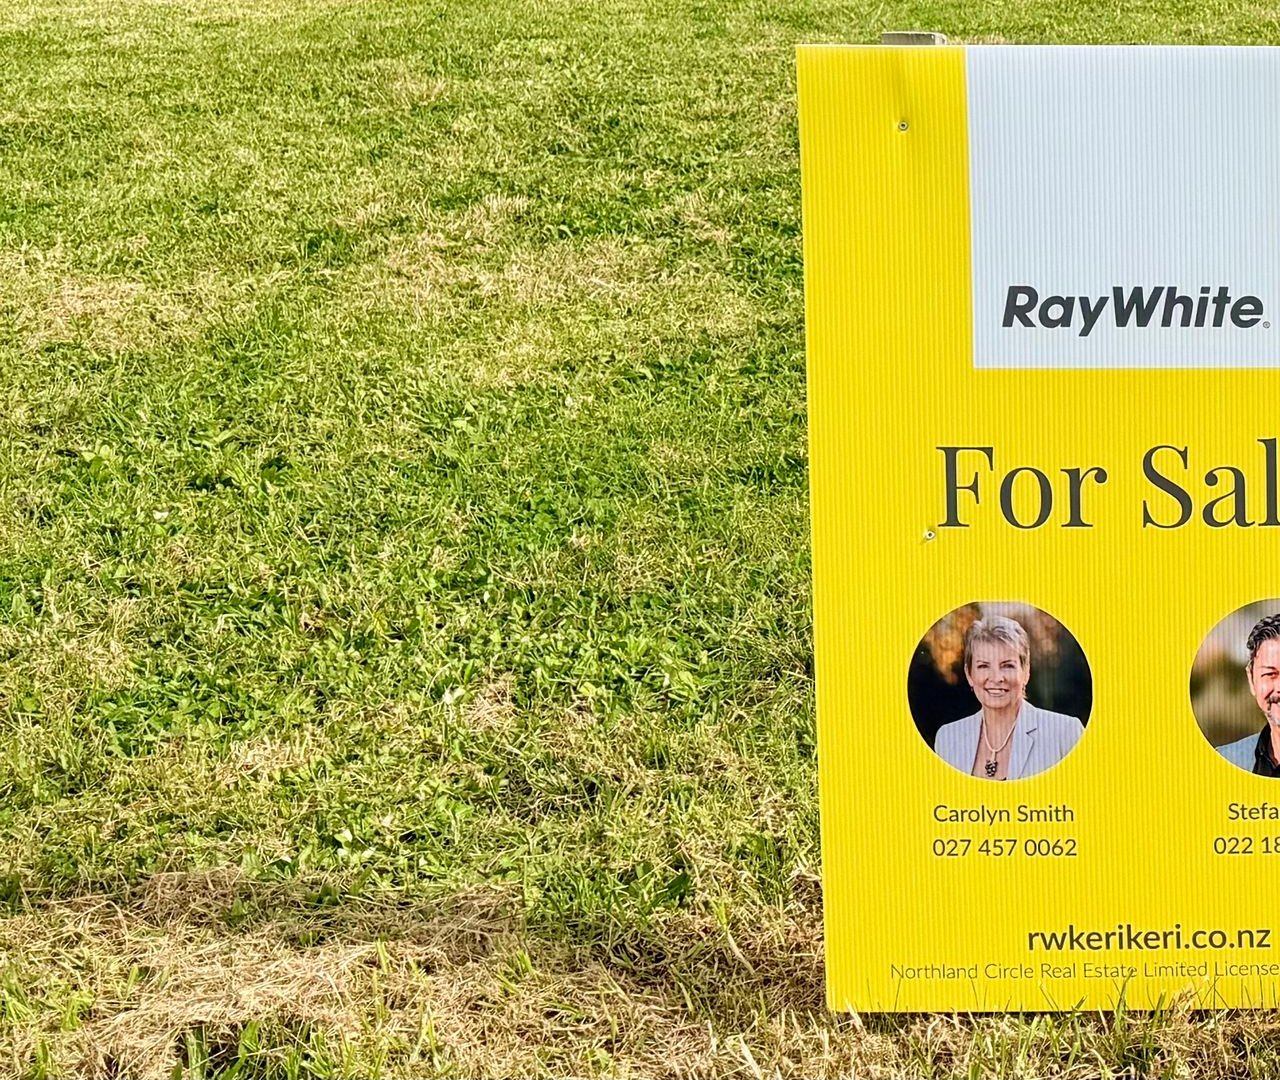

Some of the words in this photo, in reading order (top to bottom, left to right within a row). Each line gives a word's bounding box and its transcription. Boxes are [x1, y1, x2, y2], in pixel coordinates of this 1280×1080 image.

[935, 445, 1108, 529] For
[933, 804, 1011, 826] Carolyn
[1016, 804, 1075, 823] Smith
[932, 838, 972, 857] 027
[978, 838, 1018, 857] 457
[1024, 838, 1078, 857] 0062
[1213, 836, 1254, 855] 022
[1028, 923, 1272, 951] rwkerikeri.co.nz
[890, 963, 978, 980] Northland
[984, 963, 1035, 979] Circle
[1040, 962, 1077, 979] Real
[1083, 962, 1138, 979] Estate
[1144, 961, 1208, 978] Limited
